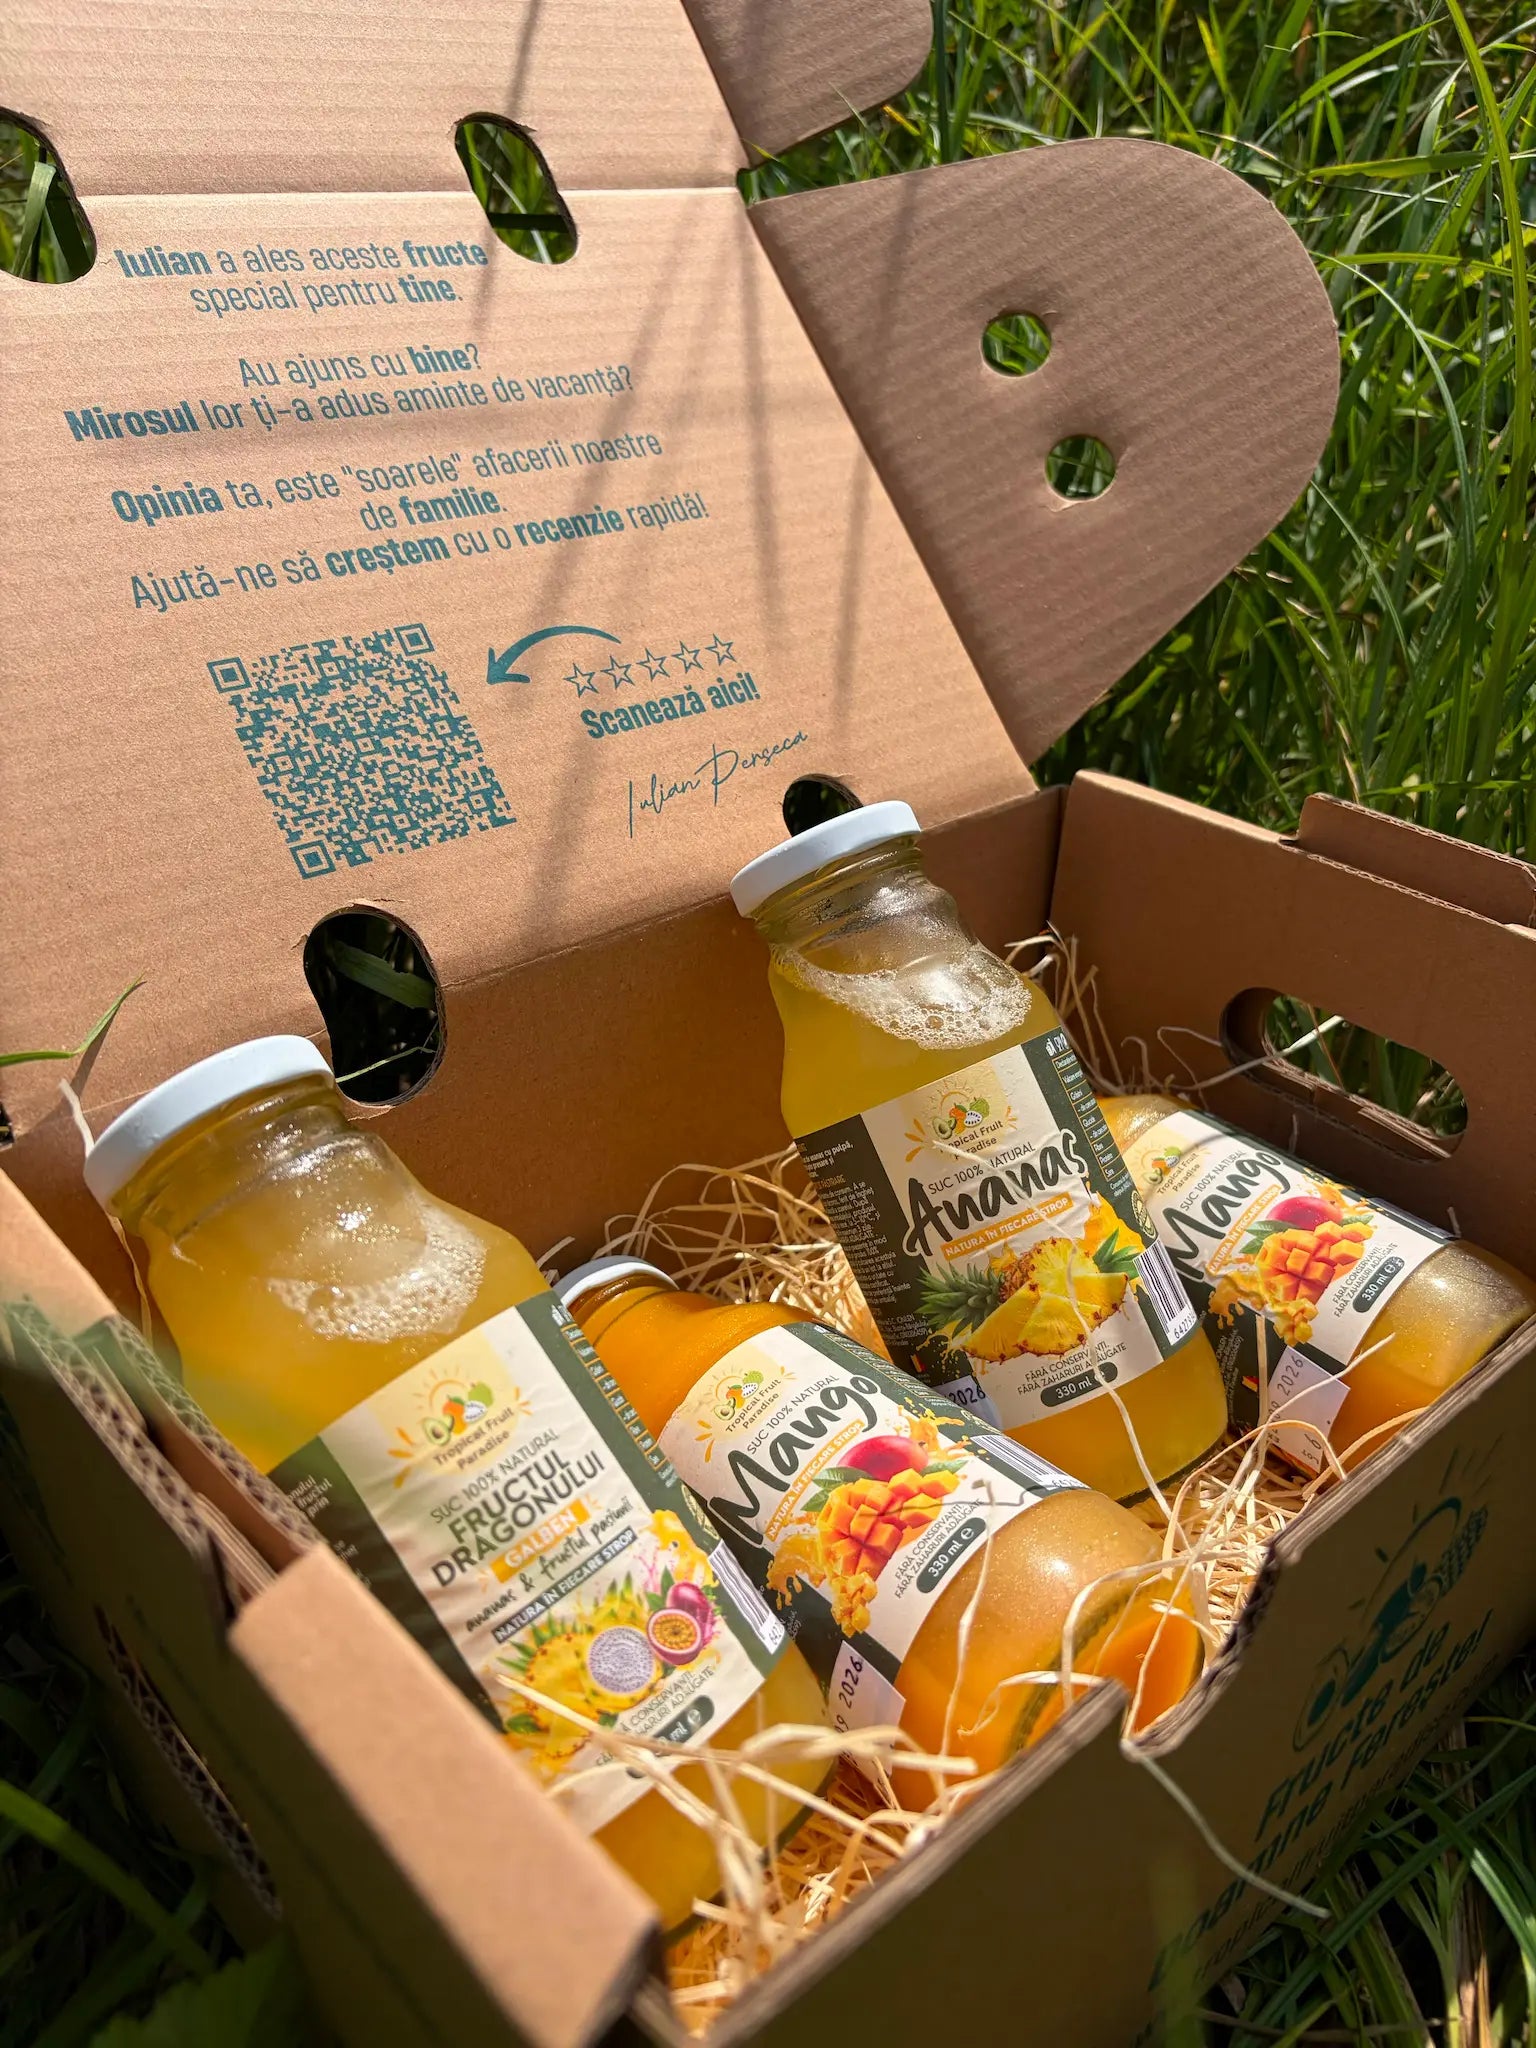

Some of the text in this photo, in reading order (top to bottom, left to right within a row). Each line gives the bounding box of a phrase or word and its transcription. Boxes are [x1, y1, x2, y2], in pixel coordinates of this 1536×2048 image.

[114, 240, 488, 278] Iulian a ales aceste fructe
[190, 274, 463, 319] special pentru tine.
[238, 343, 481, 389] Au ajuns cu bine?
[64, 365, 634, 442] Mirosul lor ți-a adus aminte de vacanță?
[111, 433, 663, 527] Opinia ta, este "soarele" afacerii noastre
[360, 487, 508, 531] de familie.
[131, 491, 710, 613] Ajută-ne să creștem cu o recenzie rapidă!
[580, 671, 761, 739] Scanează aici!
[954, 1138, 997, 1160] radise
[979, 1120, 1004, 1136] Fruit
[906, 1134, 1086, 1256] Ananas
[928, 1176, 954, 1195] SUC
[954, 1164, 984, 1183] 100%
[1157, 1166, 1184, 1194] Tropical
[1182, 1152, 1200, 1167] Fruit
[1172, 1164, 1200, 1192] Paradise
[1180, 1150, 1246, 1211] SUC 100% NATURAL
[946, 1197, 1069, 1257] NATURA ÎN FIECARE STROP
[1162, 1151, 1290, 1280] Mango
[1346, 1268, 1372, 1299] ZAHARURI
[1362, 1274, 1388, 1300] 330 ml
[1017, 1381, 1041, 1394] FĂRĂ
[1041, 1366, 1084, 1387] ZAHARURI
[1025, 1366, 1048, 1382] FĂRĂ
[1055, 1376, 1093, 1399] 330 ml
[1277, 1355, 1304, 1396] 2026
[725, 1379, 781, 1432] Tropical Fruit
[742, 1393, 780, 1429] Paradise
[747, 1374, 840, 1454] SUC 100% NATURAL
[432, 1406, 515, 1467] Tropical Fruit
[456, 1430, 511, 1471] Paradise
[709, 1375, 878, 1545] Mango
[430, 1428, 561, 1524] SUC 100% NATURAL
[448, 1448, 571, 1544] FRUCTUL
[769, 1494, 795, 1538] NATURA
[801, 1446, 836, 1482] FIECARE
[834, 1422, 861, 1447] STROP
[307, 1496, 330, 1519] prin
[430, 1449, 606, 1588] DRAGONULUI
[505, 1506, 577, 1568] GALBEN
[894, 1498, 984, 1598] FĂRĂ ZAHARURI ADĂUGATE
[928, 1540, 963, 1577] 330 ml
[466, 1588, 518, 1633] ananas
[519, 1572, 535, 1593] &
[538, 1525, 590, 1580] fructul
[590, 1495, 635, 1544] pasiunii
[494, 1528, 636, 1641] NATURA ÎN FIECARE STROP
[895, 1555, 915, 1580] FĂRĂ
[839, 1655, 863, 1709] 2026
[1254, 1678, 1396, 1843] Fructe
[1398, 1620, 1451, 1691] de
